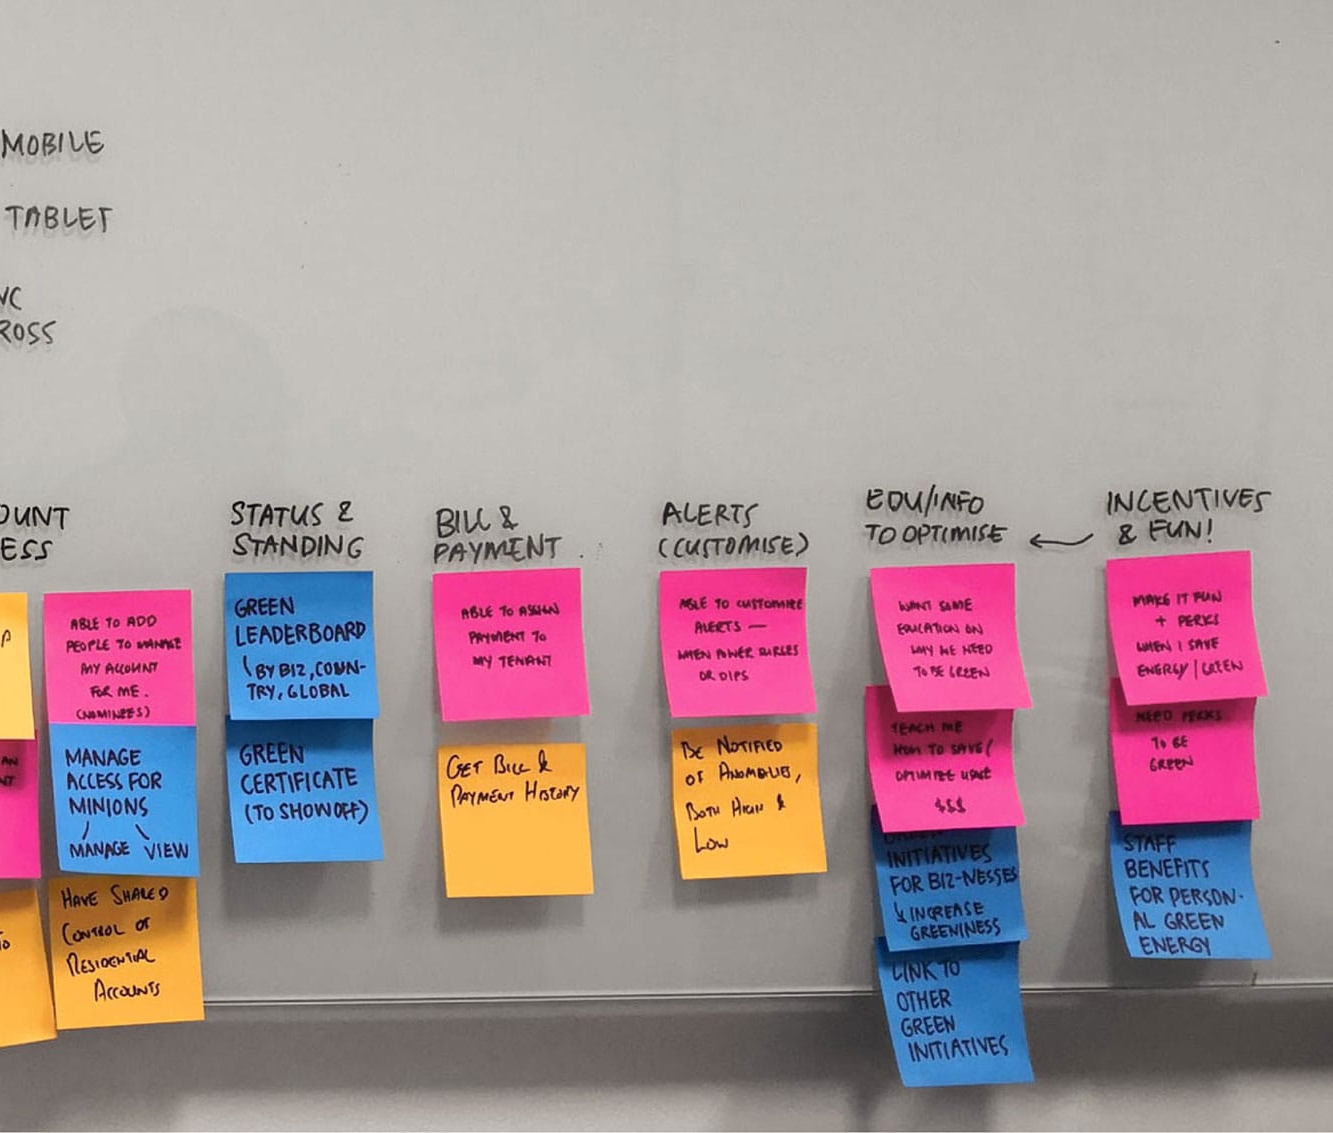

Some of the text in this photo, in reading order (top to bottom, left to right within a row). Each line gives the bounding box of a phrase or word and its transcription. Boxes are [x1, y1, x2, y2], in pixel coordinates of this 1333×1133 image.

[2, 129, 104, 158] MOBILE
[5, 206, 112, 232] TABLET
[867, 484, 984, 517] EDU/INFO
[1107, 488, 1272, 515] INCENTIVES
[232, 501, 353, 527] STATUS &
[436, 506, 518, 538] BILL &
[663, 502, 758, 528] ALERTS
[865, 524, 1008, 545] TO OPTIMISE
[1119, 519, 1213, 545] & FUN!
[233, 533, 364, 558] STANDING
[434, 534, 562, 564] PAYMENT
[659, 533, 809, 558] (CUSTOMISE)
[235, 597, 294, 618] GREEN
[1177, 594, 1189, 604] IT
[71, 616, 156, 630] ABLE TO ADD
[462, 606, 514, 619] ABLE TO
[236, 621, 366, 647] LEADERBOARD
[695, 622, 741, 633] ALERTS
[116, 639, 131, 650] TO
[499, 655, 552, 667] TENANT
[256, 665, 274, 679] BY
[720, 671, 749, 680] DIPS
[288, 684, 349, 699] GLOBAL
[66, 749, 141, 766] MANAGE
[239, 742, 304, 766] GREEN
[67, 772, 162, 790] ACCESS FOR
[241, 768, 358, 795] CERTIFICATE
[69, 797, 148, 817] MINIONS
[245, 802, 332, 824] (TO SHOW
[70, 841, 188, 859] MANAGE VIEW
[1124, 834, 1176, 853] STAFF
[887, 843, 992, 868] INITIATIVES
[1124, 859, 1210, 879] BENEFITS
[890, 875, 924, 896] FOR
[1129, 886, 1164, 906] FOR
[910, 901, 984, 921] INCREASE
[1134, 912, 1224, 931] AL GREEN
[911, 918, 1002, 942] GREENINESS
[1140, 936, 1211, 956] ENERGY
[892, 960, 960, 982] LINK TO
[896, 989, 952, 1012] OTHER
[901, 1016, 955, 1038] GREEN
[908, 1034, 1009, 1062] INITIATIVES
